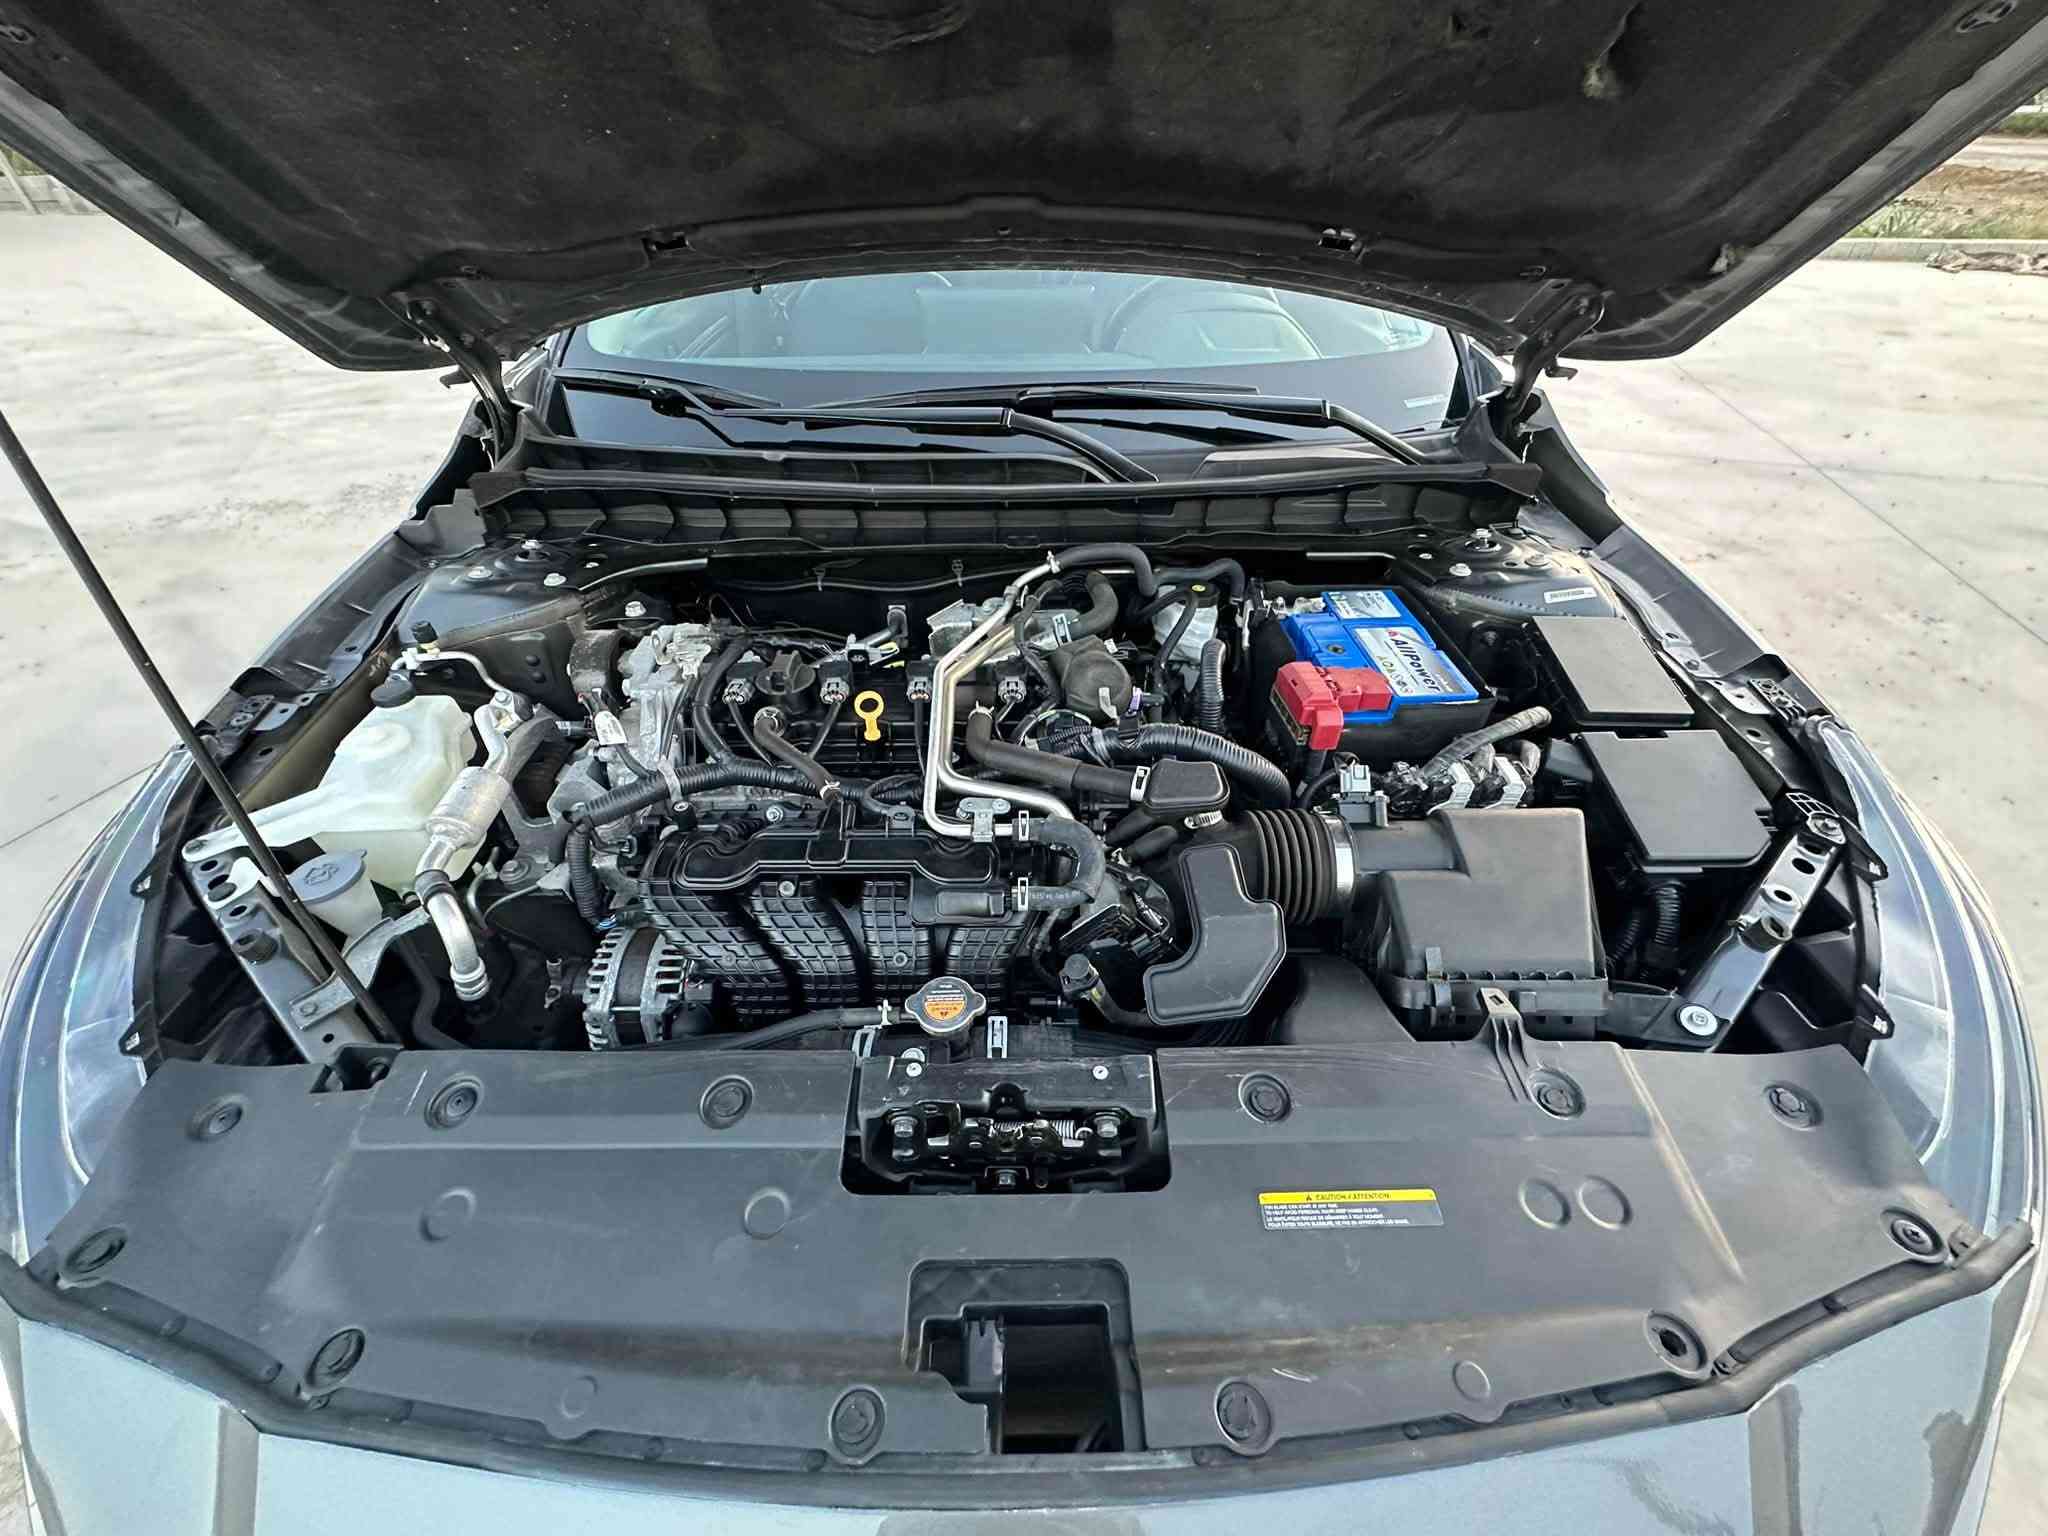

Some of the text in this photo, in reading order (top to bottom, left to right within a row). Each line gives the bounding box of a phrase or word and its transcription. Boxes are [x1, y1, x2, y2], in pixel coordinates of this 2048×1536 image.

[1390, 638, 1440, 691] AllPower
[1315, 1193, 1346, 1201] CAUTION
[1353, 1192, 1390, 1200] ATTENTION
